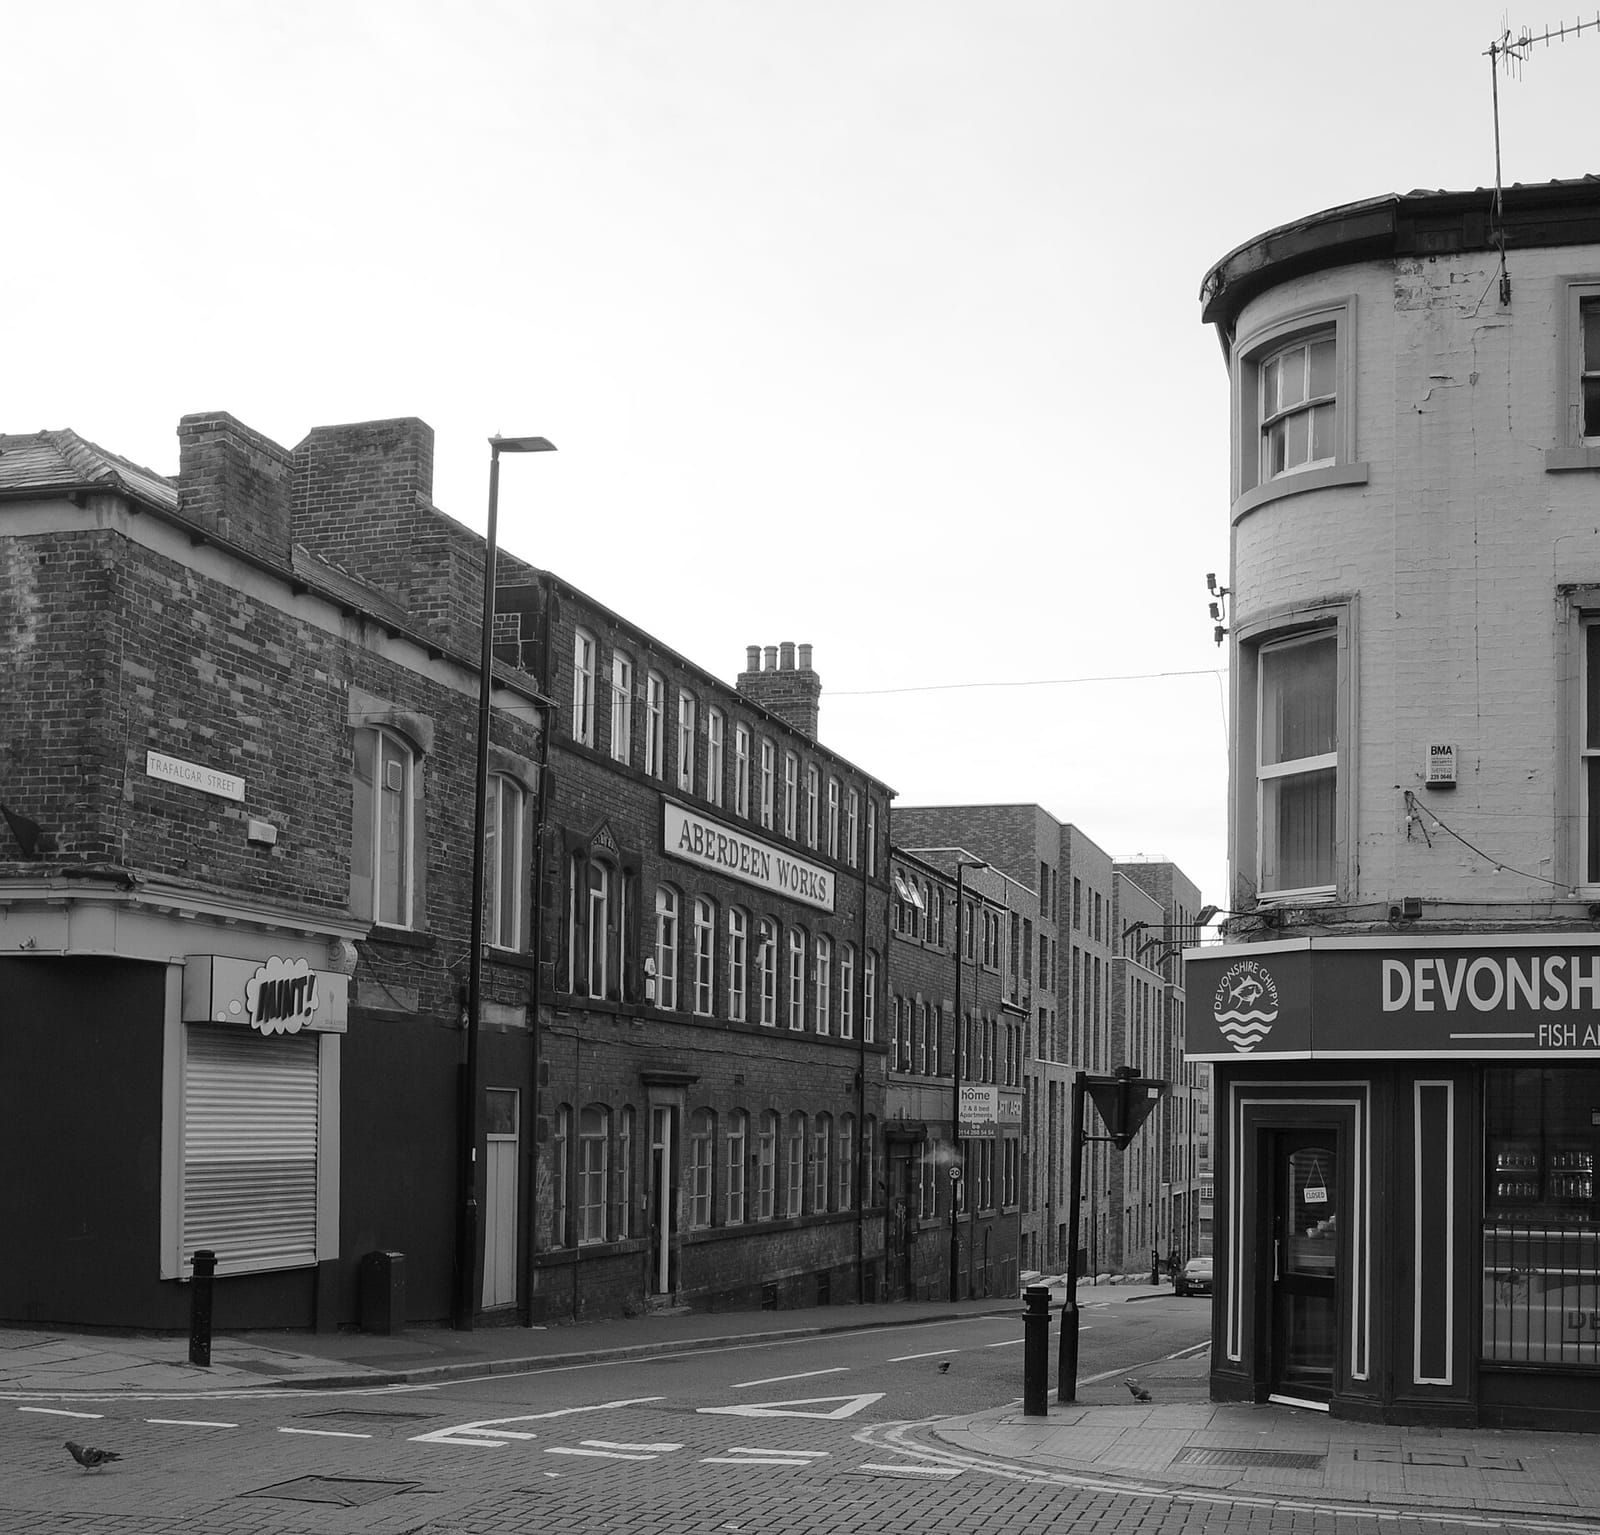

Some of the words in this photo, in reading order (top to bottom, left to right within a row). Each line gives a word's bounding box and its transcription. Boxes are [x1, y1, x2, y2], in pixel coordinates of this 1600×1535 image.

[1431, 746, 1452, 755] BMA
[150, 758, 203, 784] TRAFALGAR
[207, 774, 236, 793] STREET
[679, 819, 770, 881] ABERDEEN
[255, 974, 316, 1024] MINT!
[1213, 960, 1260, 1010] DEVONSHIRE
[1259, 968, 1279, 1007] CHIPPY
[1382, 955, 1600, 1012] DEVONSH
[1538, 1023, 1576, 1047] FISH
[1582, 1023, 1600, 1047] A
[1306, 1191, 1325, 1199] CLOSED
